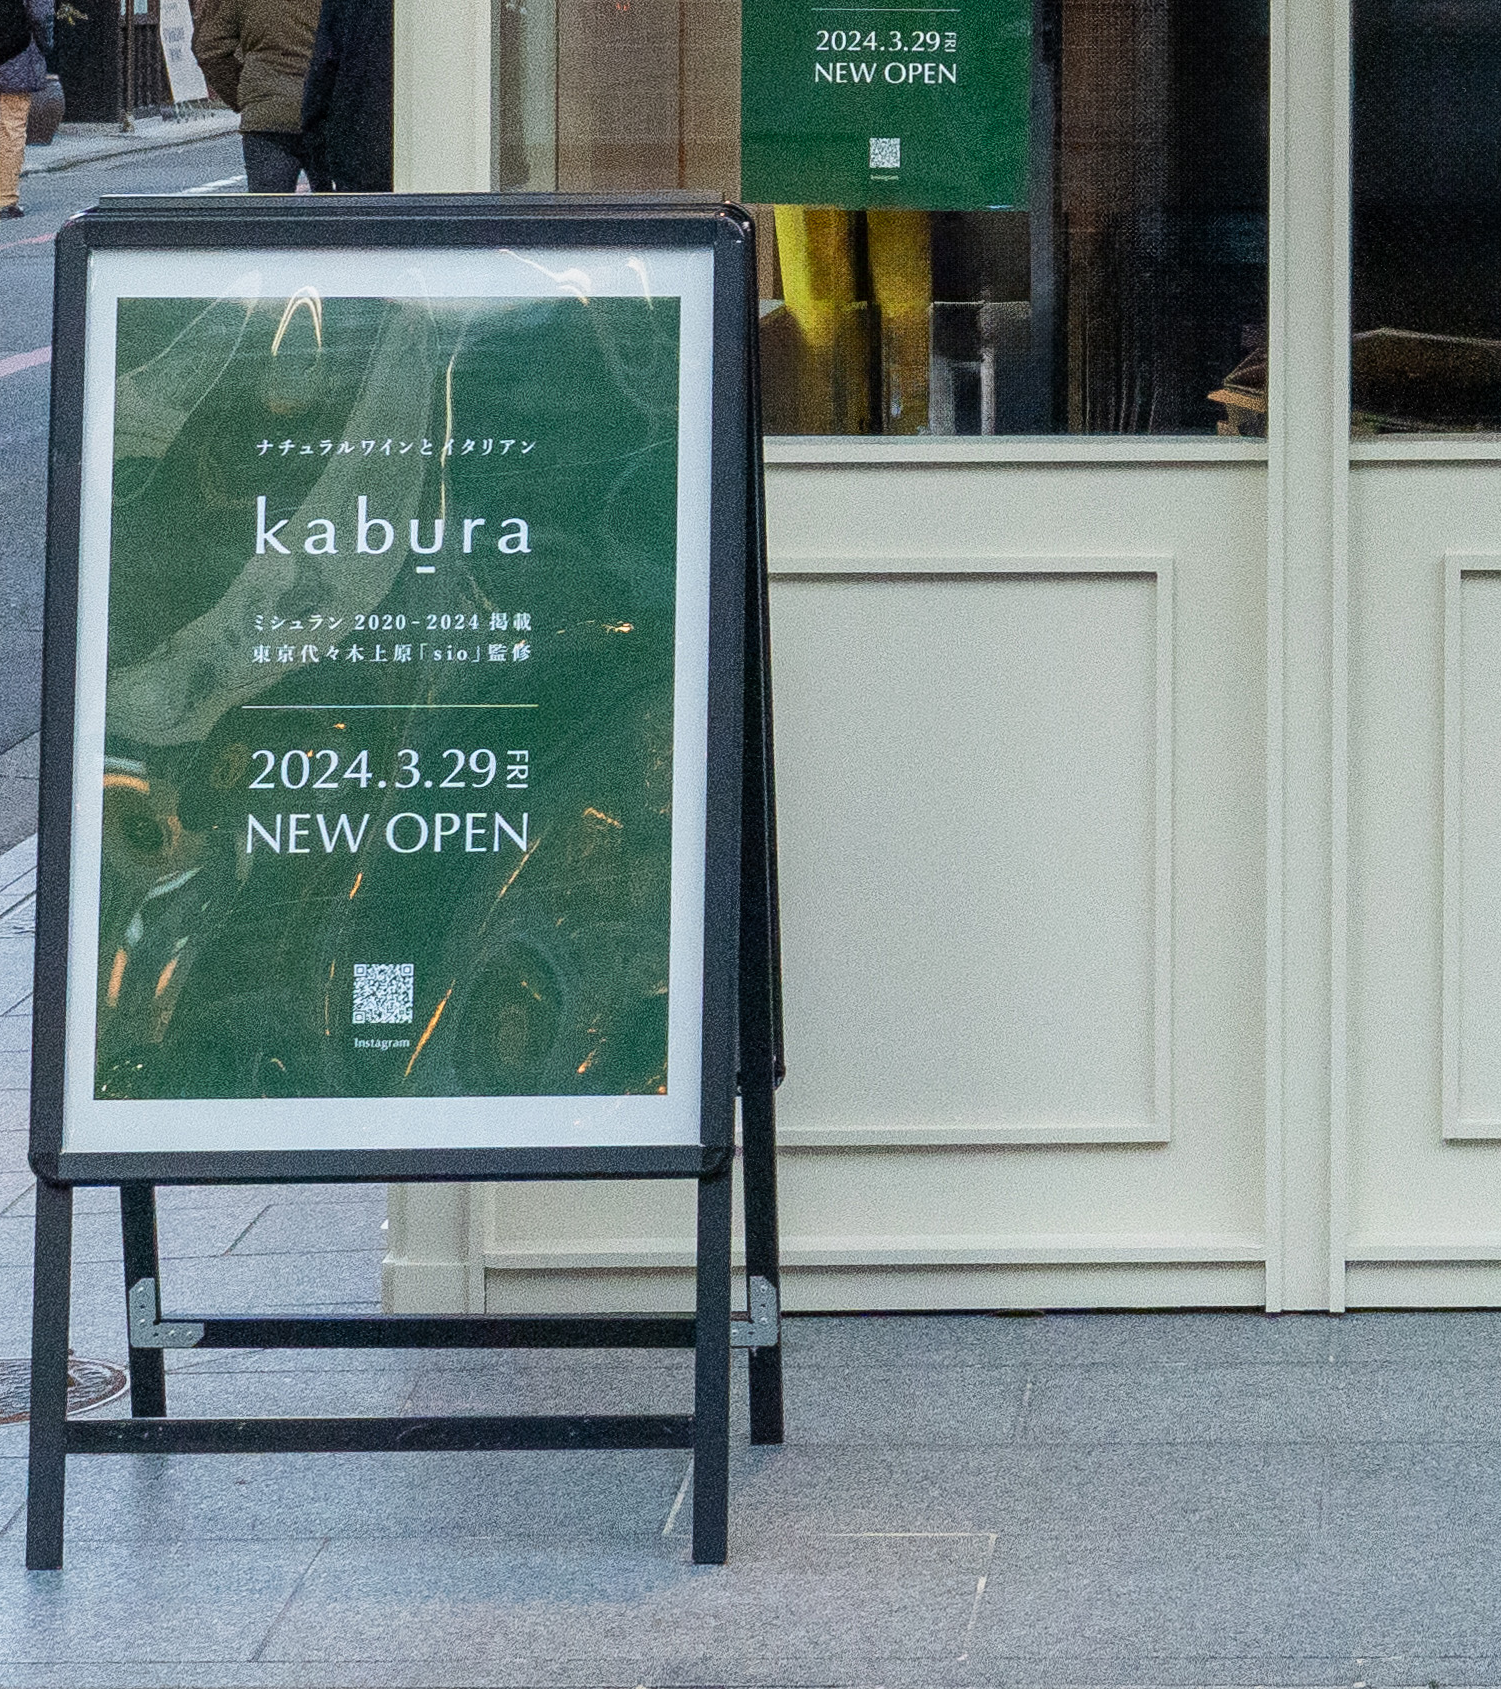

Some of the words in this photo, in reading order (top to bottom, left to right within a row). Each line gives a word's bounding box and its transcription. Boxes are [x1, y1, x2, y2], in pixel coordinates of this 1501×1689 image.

[816, 30, 941, 52] 2024.3.29
[944, 31, 956, 53] FRI
[815, 62, 877, 83] NEW
[883, 62, 957, 84] OPEN
[256, 437, 537, 457] ナチュラルワインとイタリアン
[255, 494, 532, 574] kabura
[253, 614, 345, 632] ミシュラン
[489, 612, 532, 632] 掲載
[248, 748, 497, 790] 2024.3.29
[506, 749, 530, 791] FRI
[245, 813, 371, 854] NEW
[385, 812, 530, 855] OPEN
[353, 1037, 411, 1052] Instagram
